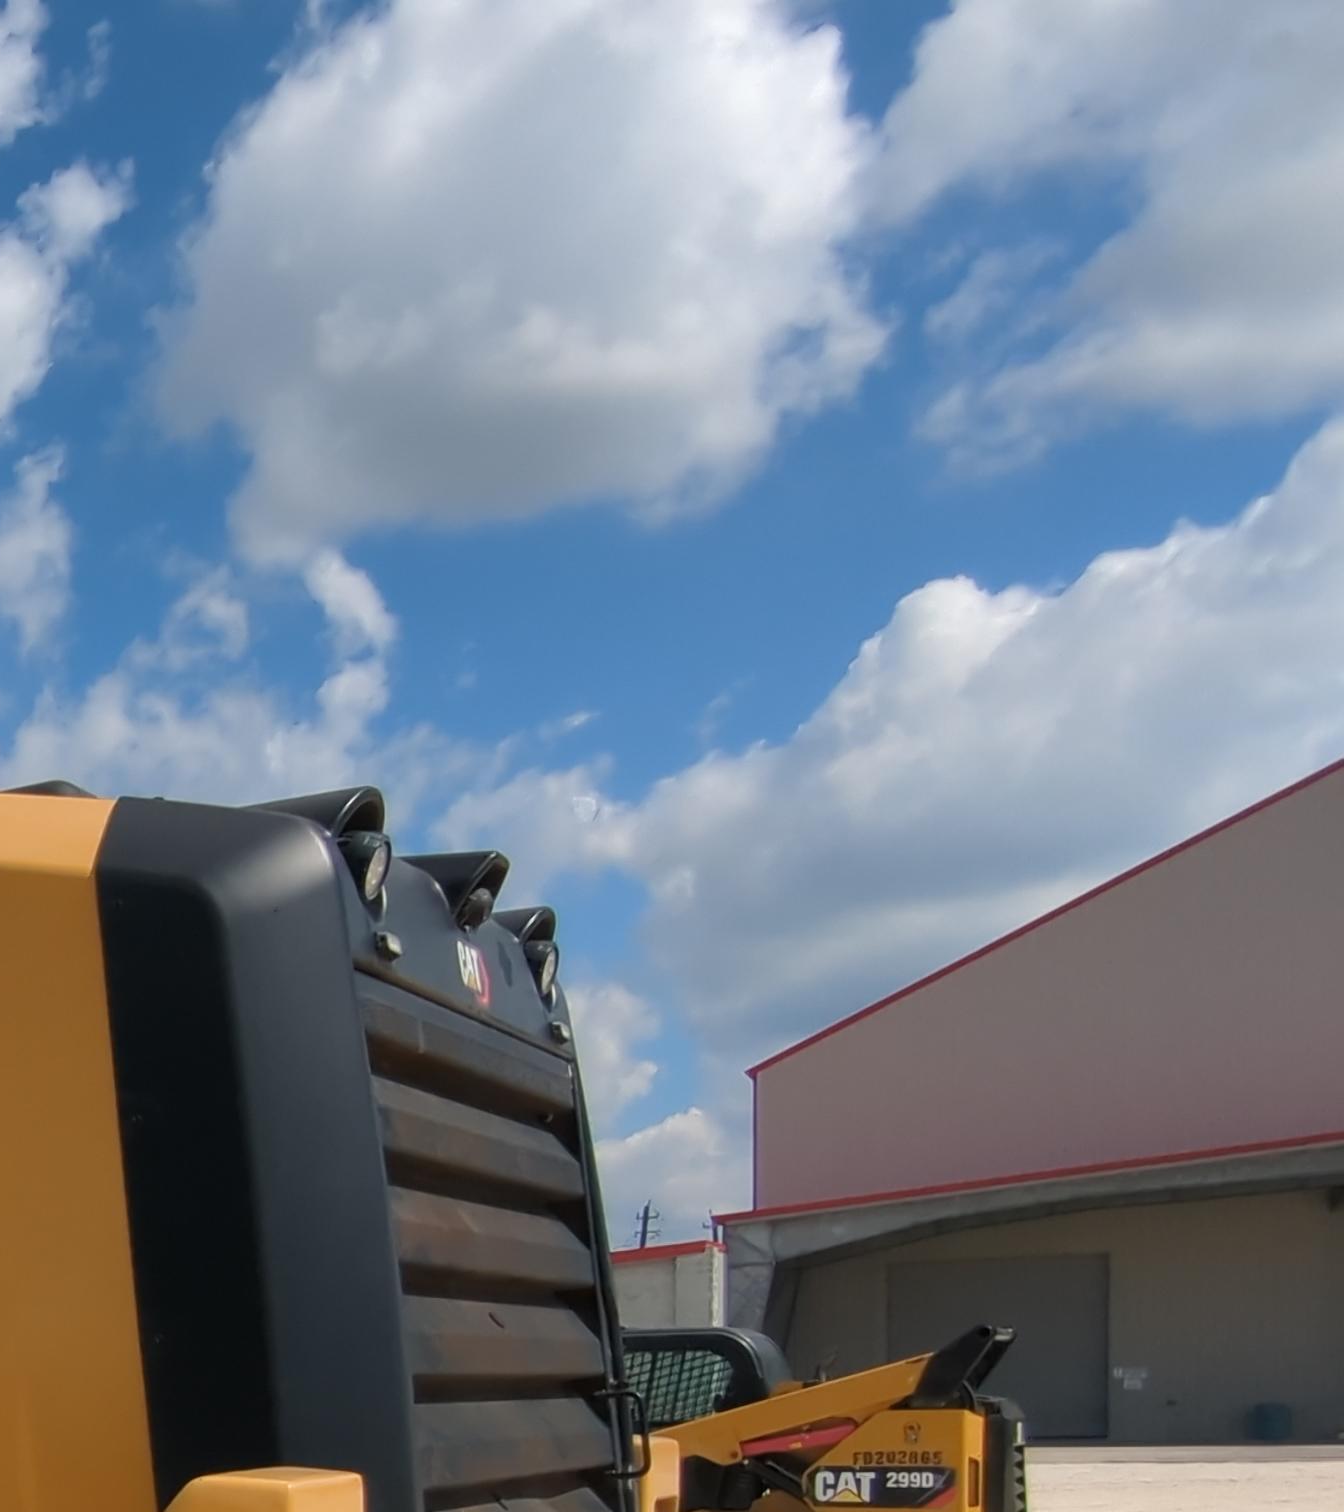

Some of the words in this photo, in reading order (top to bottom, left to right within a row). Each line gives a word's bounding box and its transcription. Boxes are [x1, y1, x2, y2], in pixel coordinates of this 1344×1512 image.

[457, 940, 482, 994] CAT
[815, 1471, 876, 1503] CAT
[886, 1471, 934, 1488] 299D
